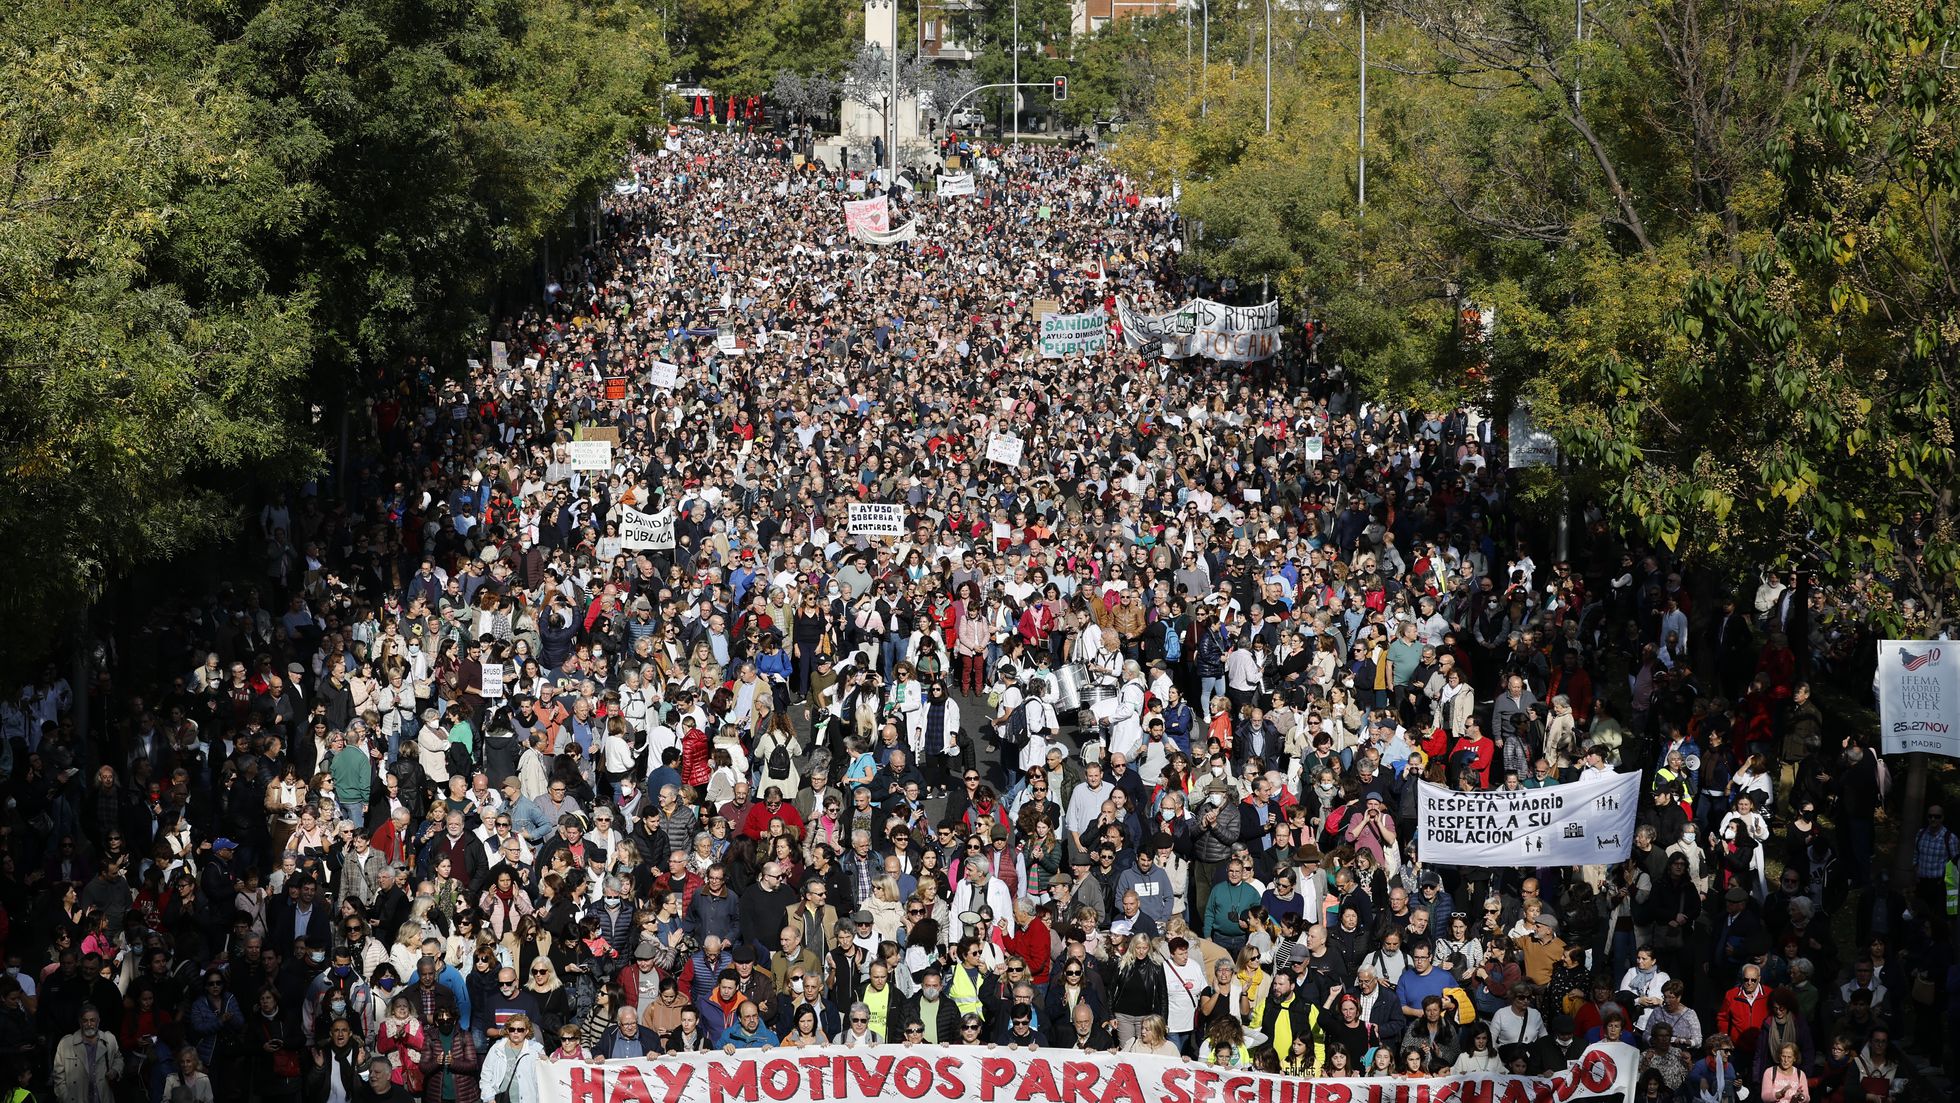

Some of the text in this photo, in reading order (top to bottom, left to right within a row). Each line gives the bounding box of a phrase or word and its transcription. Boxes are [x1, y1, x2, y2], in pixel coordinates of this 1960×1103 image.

[1045, 315, 1103, 332] SANIDAD
[860, 505, 892, 513] AYUSO
[625, 528, 673, 543] PÚBLICA
[1928, 648, 1941, 663] 10
[1902, 676, 1940, 686] IFEMA
[1902, 692, 1941, 701] HORSE
[1903, 700, 1940, 710] WEEK
[1911, 740, 1942, 749] MADRID
[1428, 798, 1499, 812] RESPETA
[1428, 812, 1551, 829] RESPETA A SU
[1428, 825, 1513, 844] POBLACIÓN
[570, 1063, 696, 1103] HAY
[708, 1054, 966, 1102] MOTIVOS
[980, 1057, 1145, 1103] PARA
